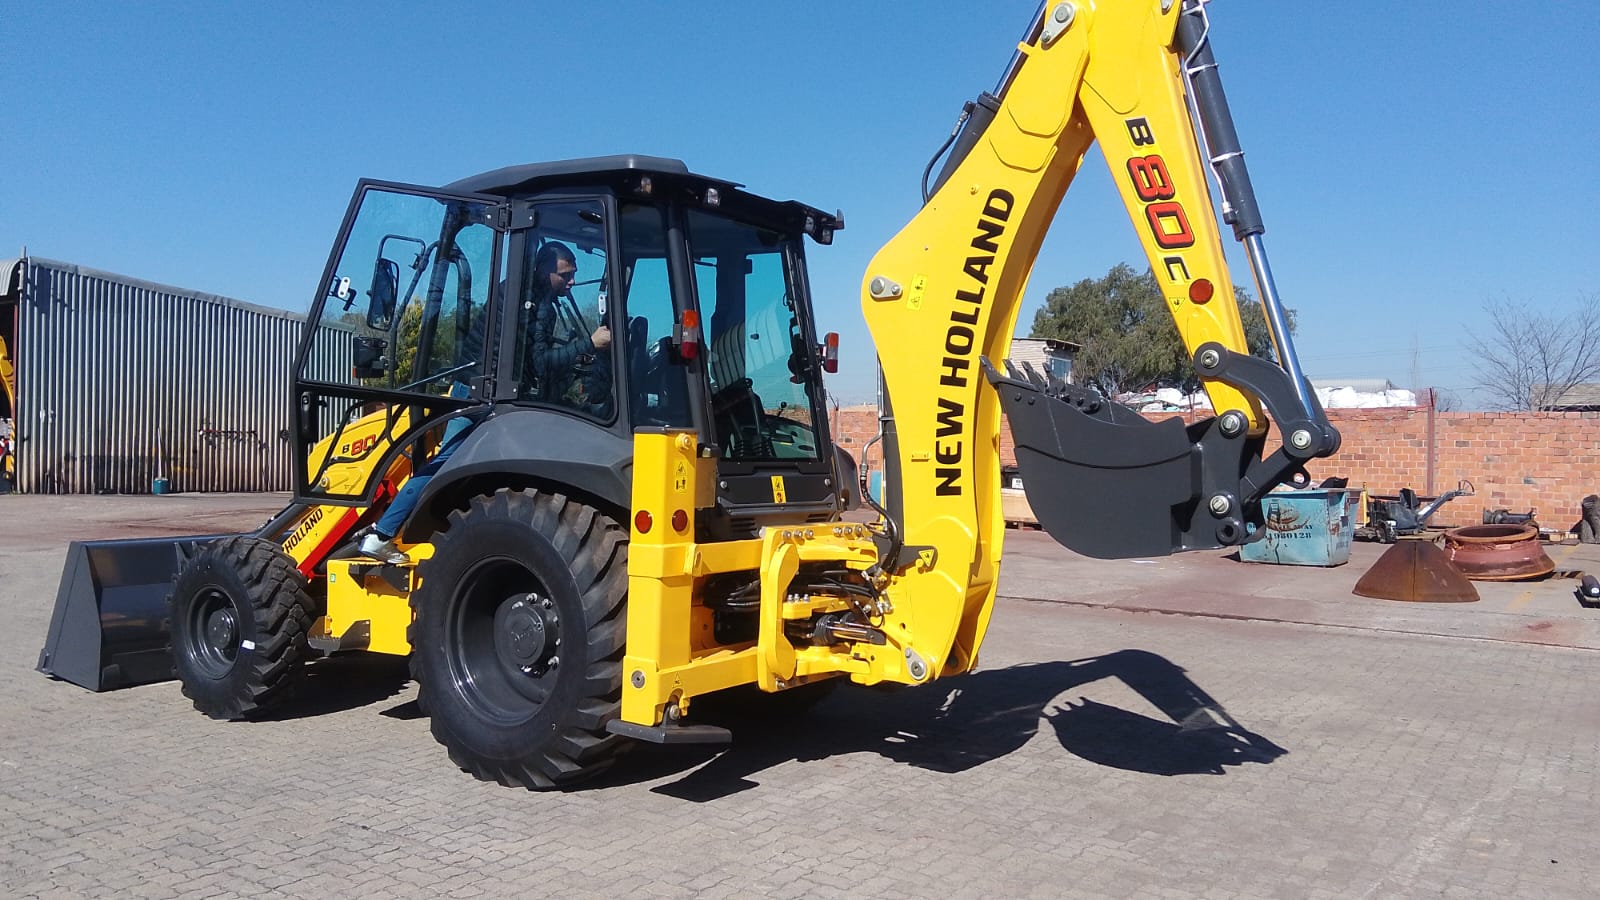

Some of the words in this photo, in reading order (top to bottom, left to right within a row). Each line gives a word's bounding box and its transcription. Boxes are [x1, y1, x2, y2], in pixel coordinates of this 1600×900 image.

[940, 188, 1015, 387] HOLLAND
[935, 397, 965, 496] NEW
[284, 508, 323, 554] HOLLAND
